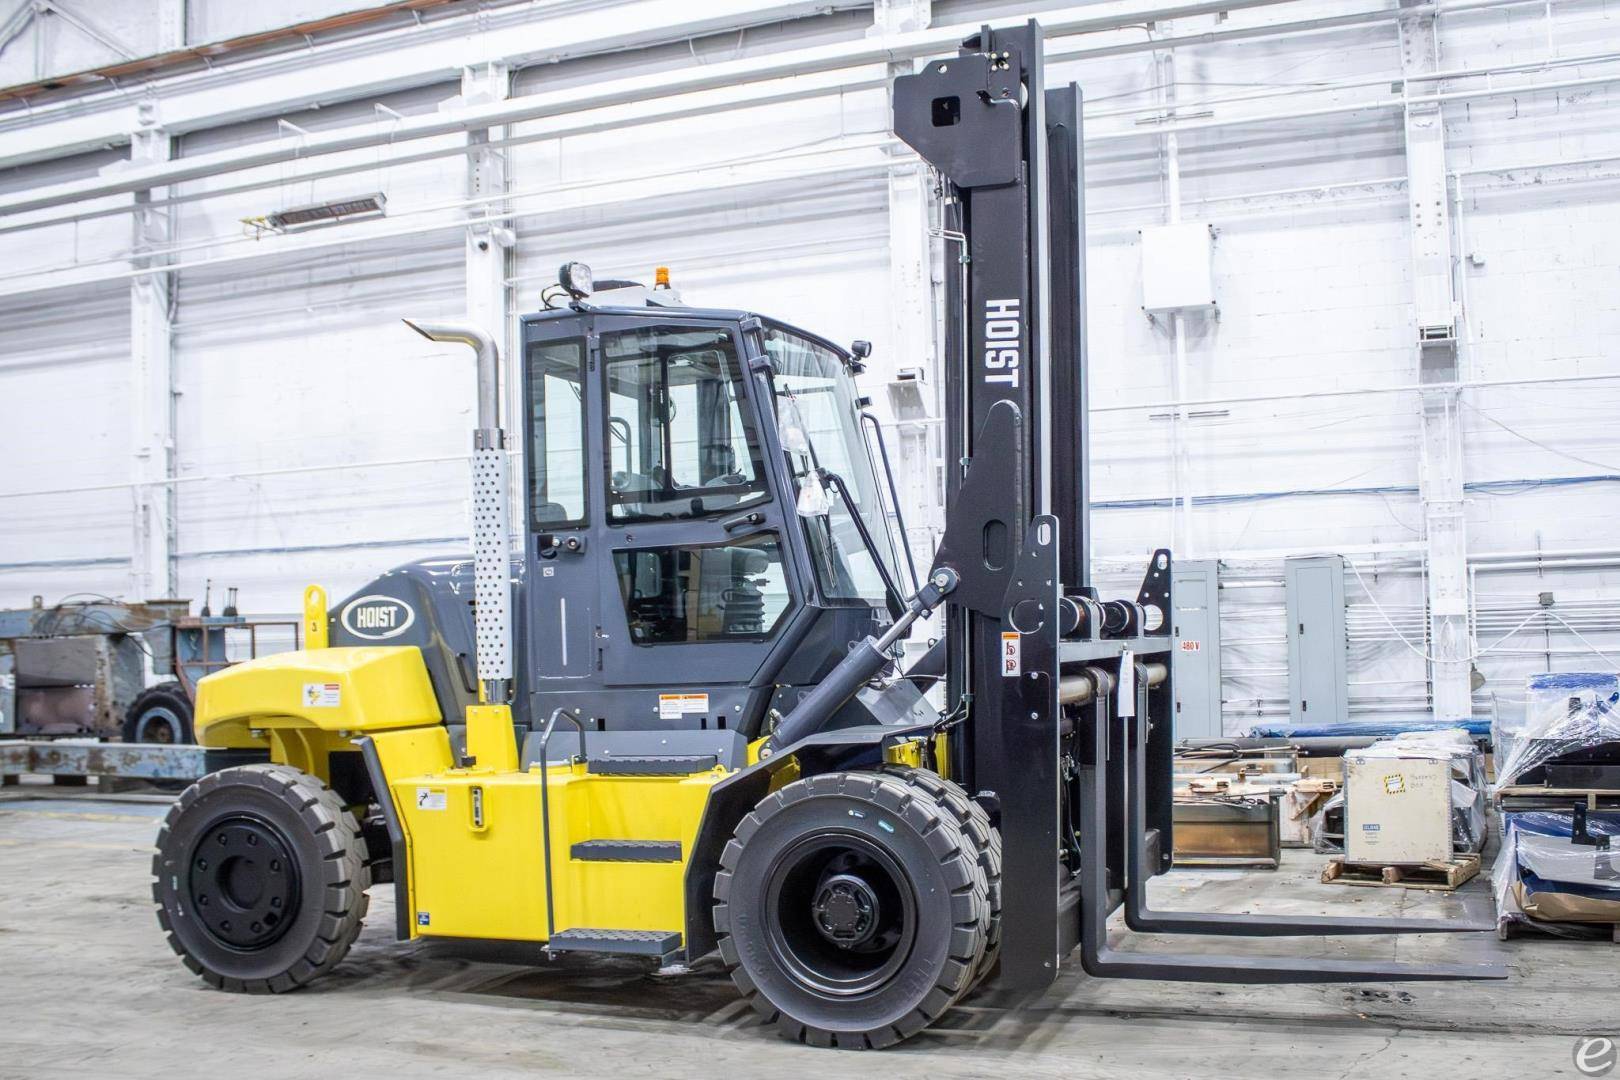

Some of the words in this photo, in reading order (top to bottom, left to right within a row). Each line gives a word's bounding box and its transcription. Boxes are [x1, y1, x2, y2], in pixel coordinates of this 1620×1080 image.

[985, 299, 1020, 387] HOIST
[357, 606, 398, 628] HOIST
[1182, 641, 1194, 650] 480
[1195, 641, 1200, 650] V
